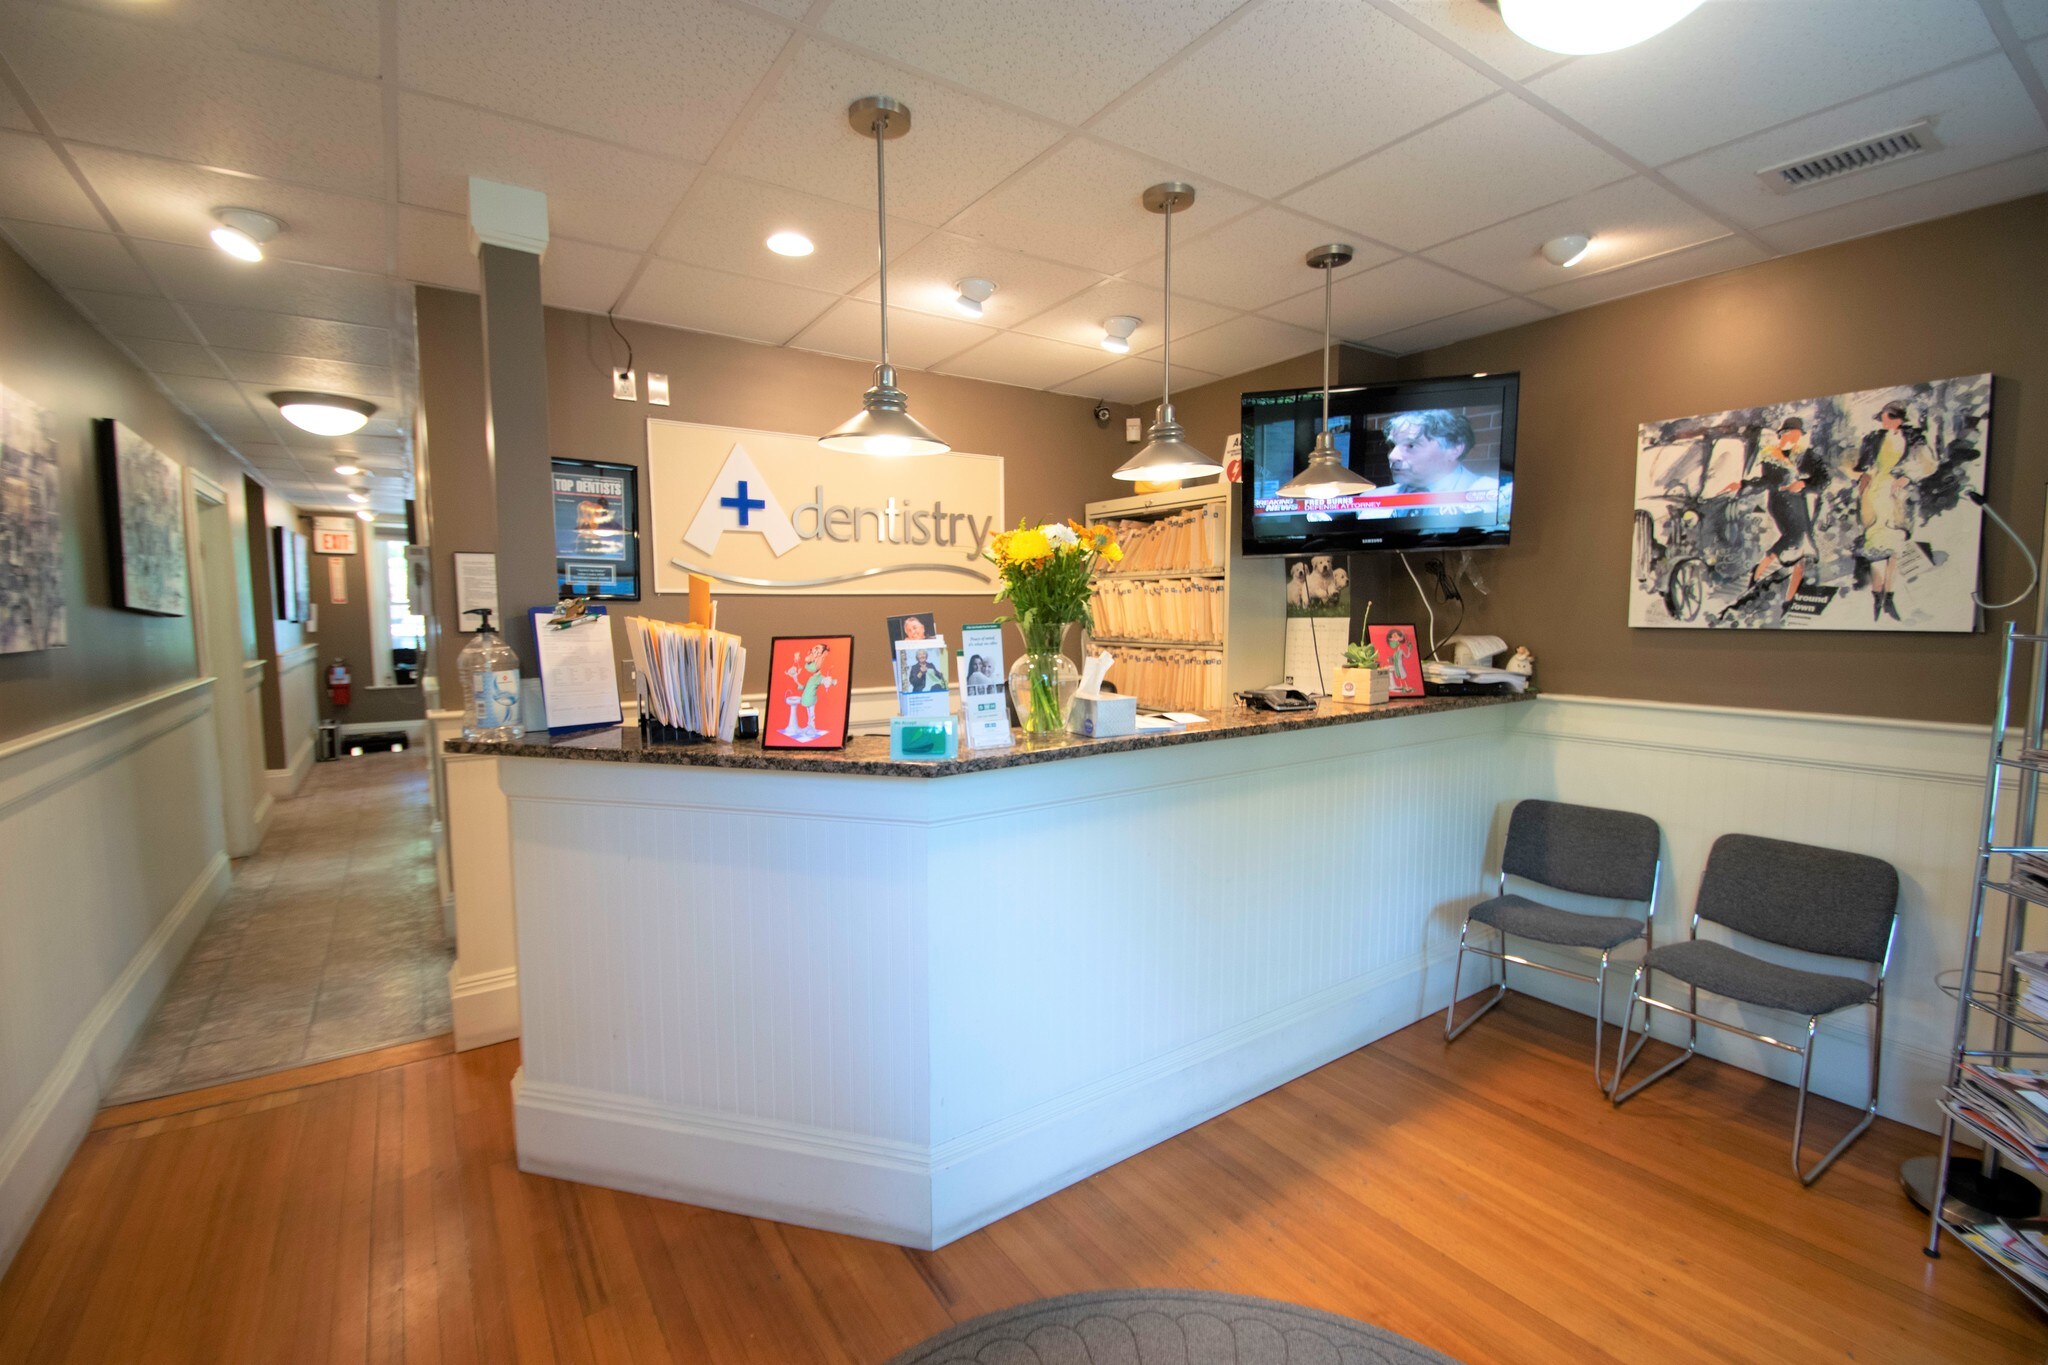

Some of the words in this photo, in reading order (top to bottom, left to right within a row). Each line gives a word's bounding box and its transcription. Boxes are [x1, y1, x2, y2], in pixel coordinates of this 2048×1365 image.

[555, 478, 574, 492] TOP
[576, 480, 622, 495] DENTISTS
[1265, 504, 1298, 512] NEWS
[1341, 501, 1381, 509] ATTORNEY
[791, 485, 993, 561] dentistry
[323, 533, 349, 550] EXIT
